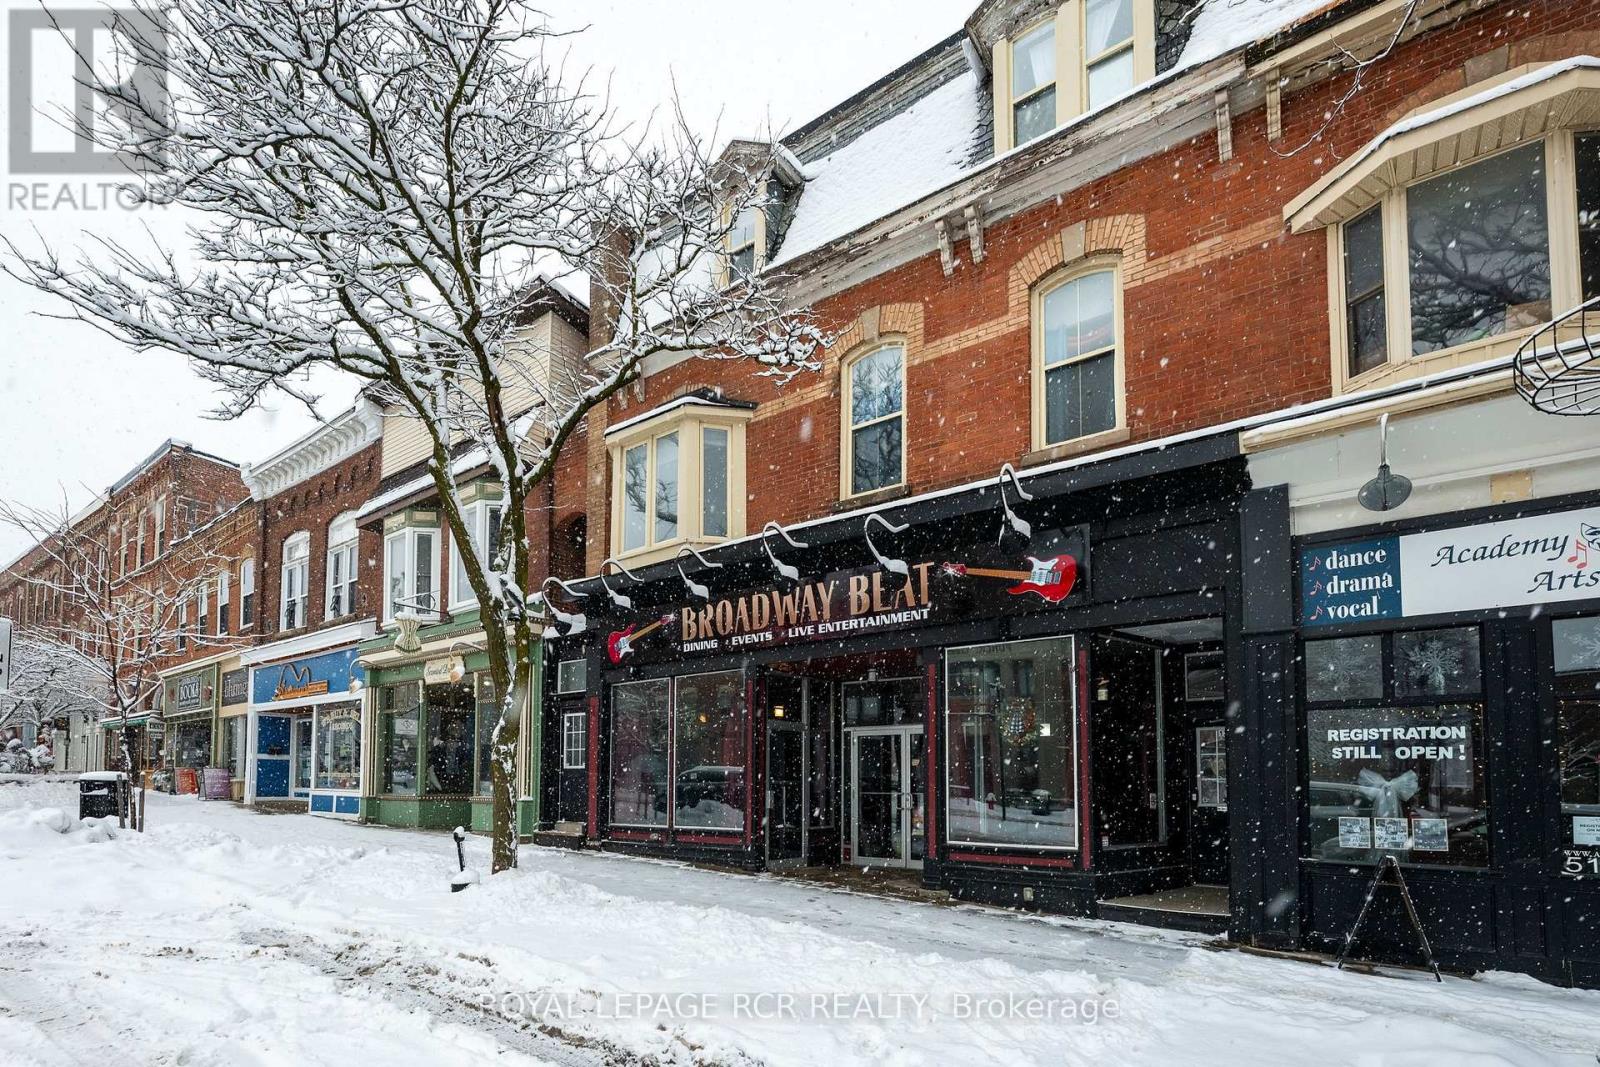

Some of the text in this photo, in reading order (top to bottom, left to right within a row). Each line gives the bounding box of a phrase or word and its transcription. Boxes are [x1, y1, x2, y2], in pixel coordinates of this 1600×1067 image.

[1325, 547, 1387, 571] dance
[1431, 534, 1569, 567] Academy
[1326, 572, 1394, 595] drama
[1527, 570, 1600, 594] Arts
[681, 562, 935, 641] BROADWAY BEAT
[1326, 596, 1380, 620] vocal
[683, 608, 931, 653] DINING EVENTS LIVE ENTERTAINMENT
[1328, 726, 1466, 742] REGISTRATION
[1331, 746, 1382, 760] STILL
